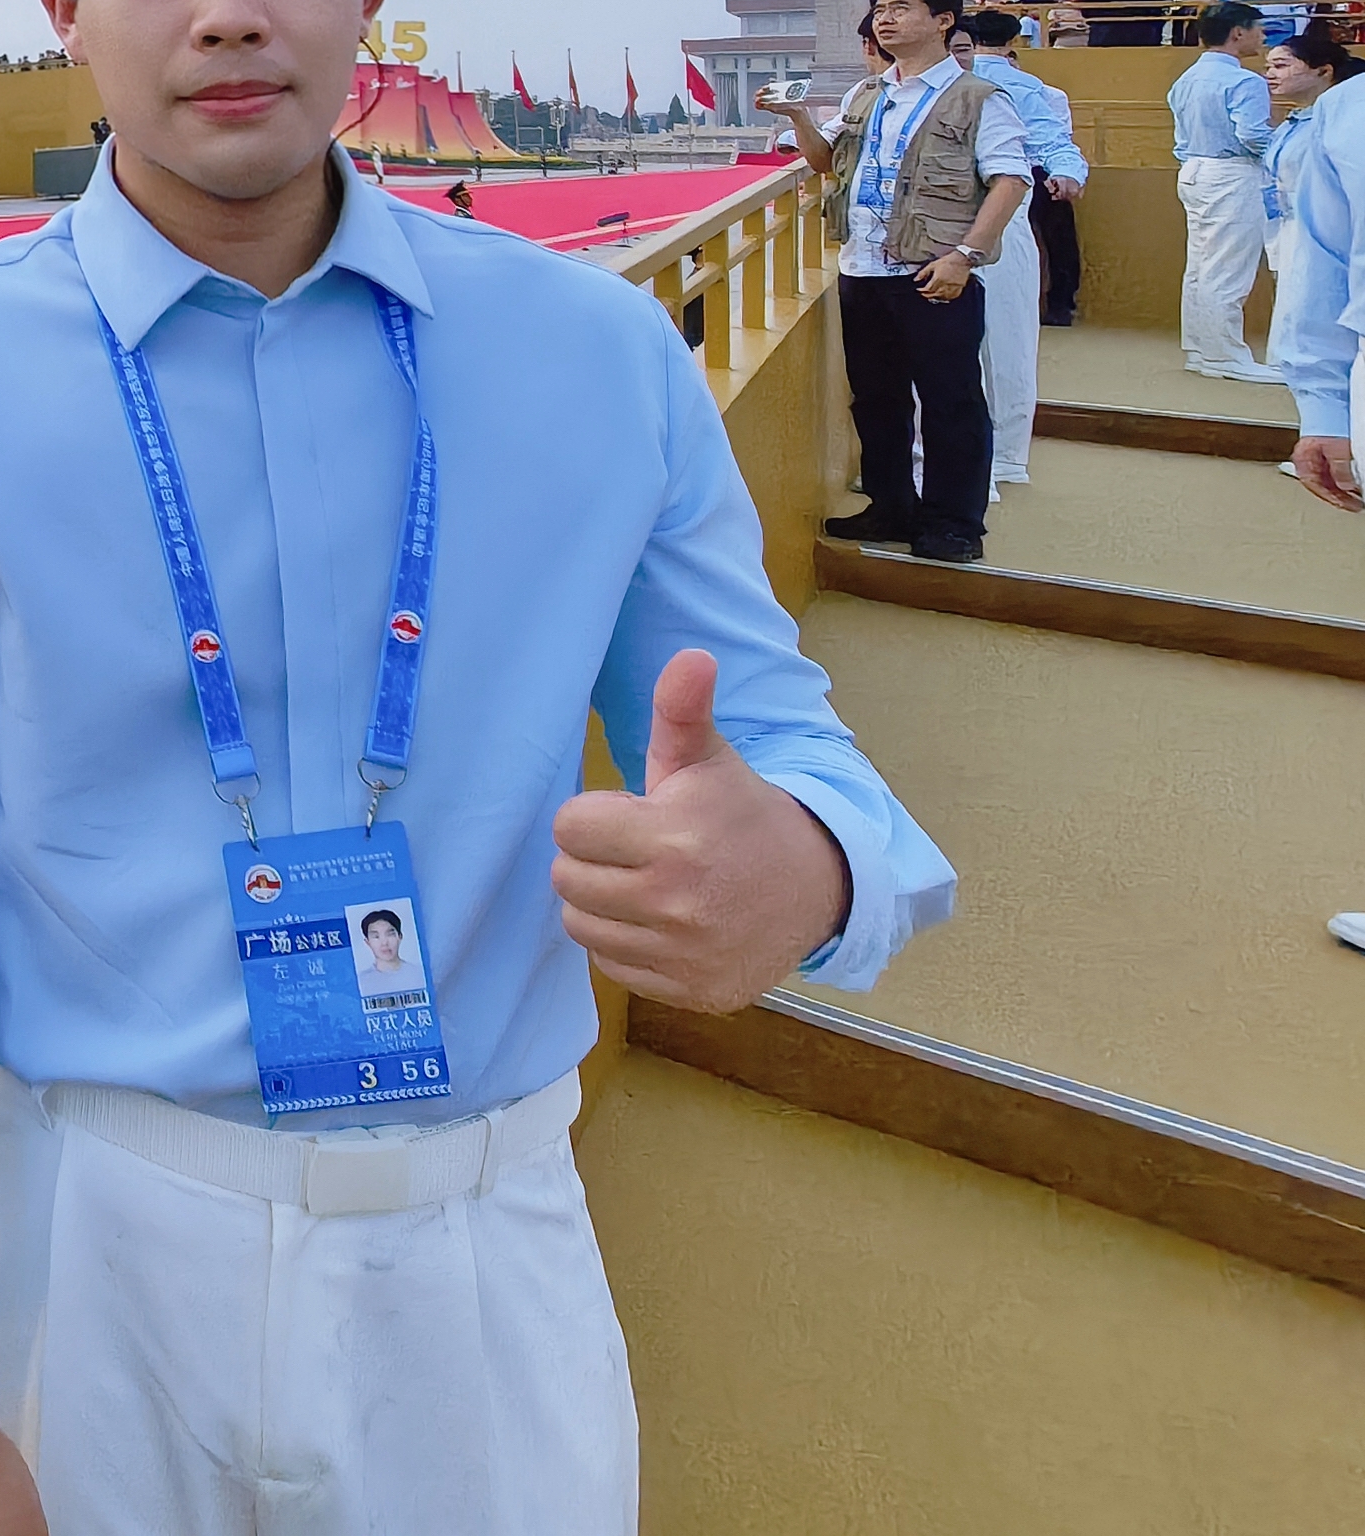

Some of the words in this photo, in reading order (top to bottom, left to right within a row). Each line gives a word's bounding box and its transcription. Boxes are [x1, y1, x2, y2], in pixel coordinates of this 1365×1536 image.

[366, 1009, 434, 1035] 仪式人员
[358, 1061, 379, 1090] 3
